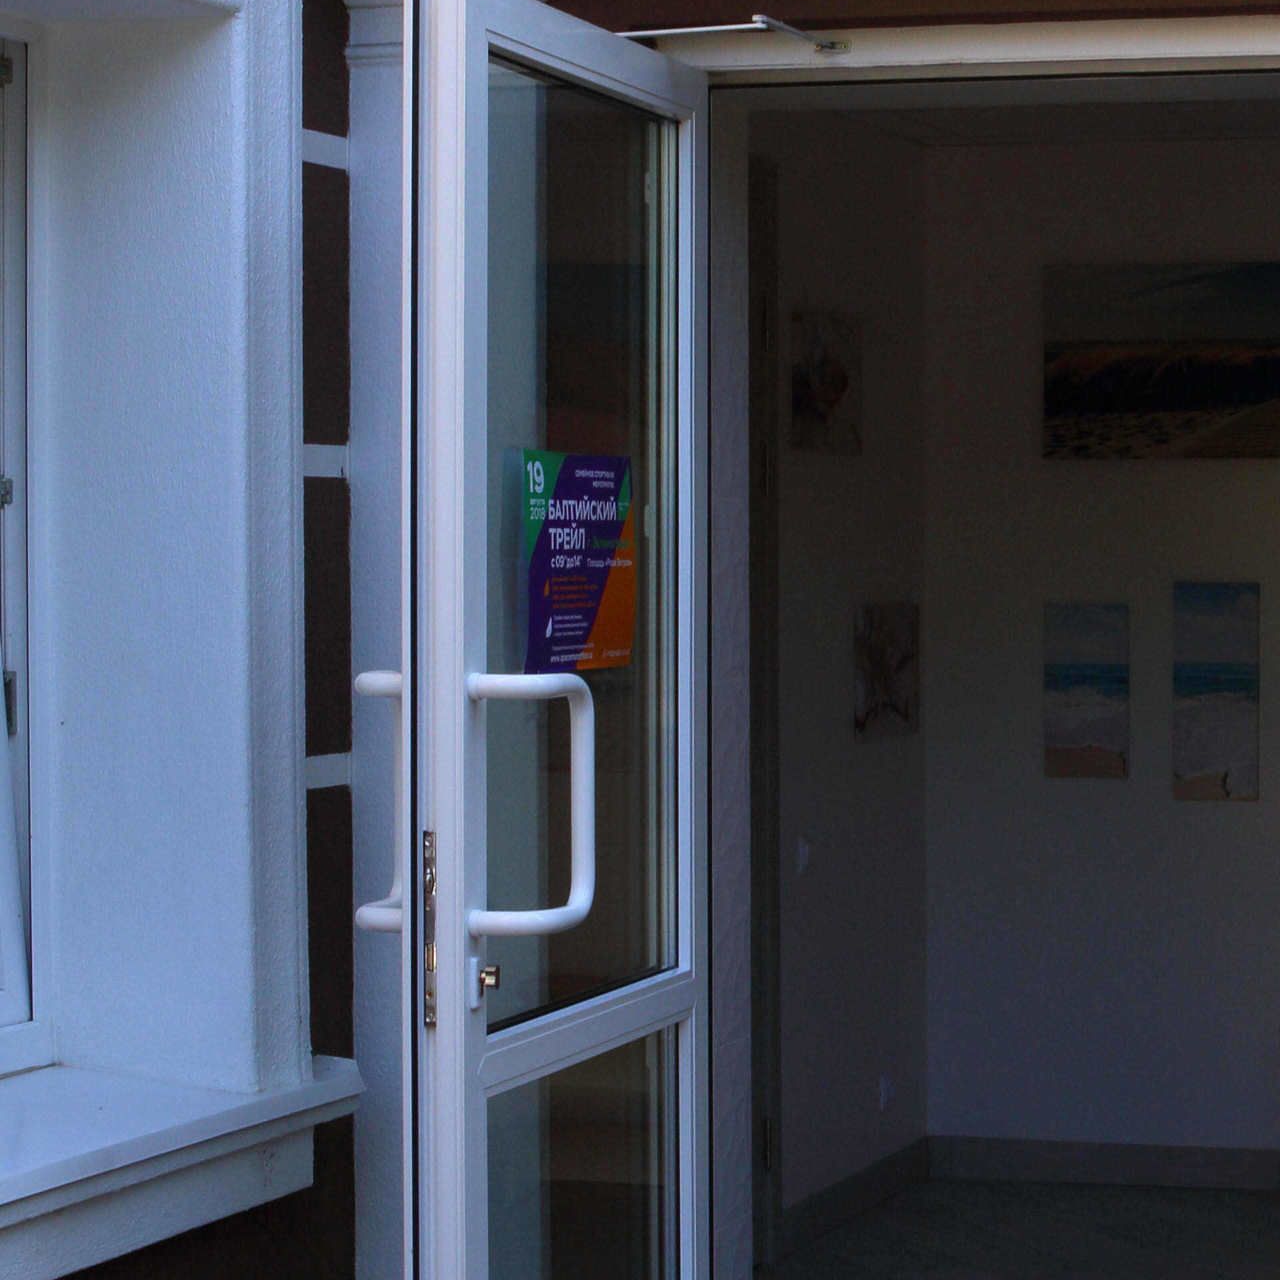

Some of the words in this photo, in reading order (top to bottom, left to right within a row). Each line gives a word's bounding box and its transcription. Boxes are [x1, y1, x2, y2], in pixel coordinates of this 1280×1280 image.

[527, 460, 545, 494] 19
[548, 495, 617, 521] БАЛТИЙСКИЙ
[548, 522, 586, 550] ТРЕЙЛ
